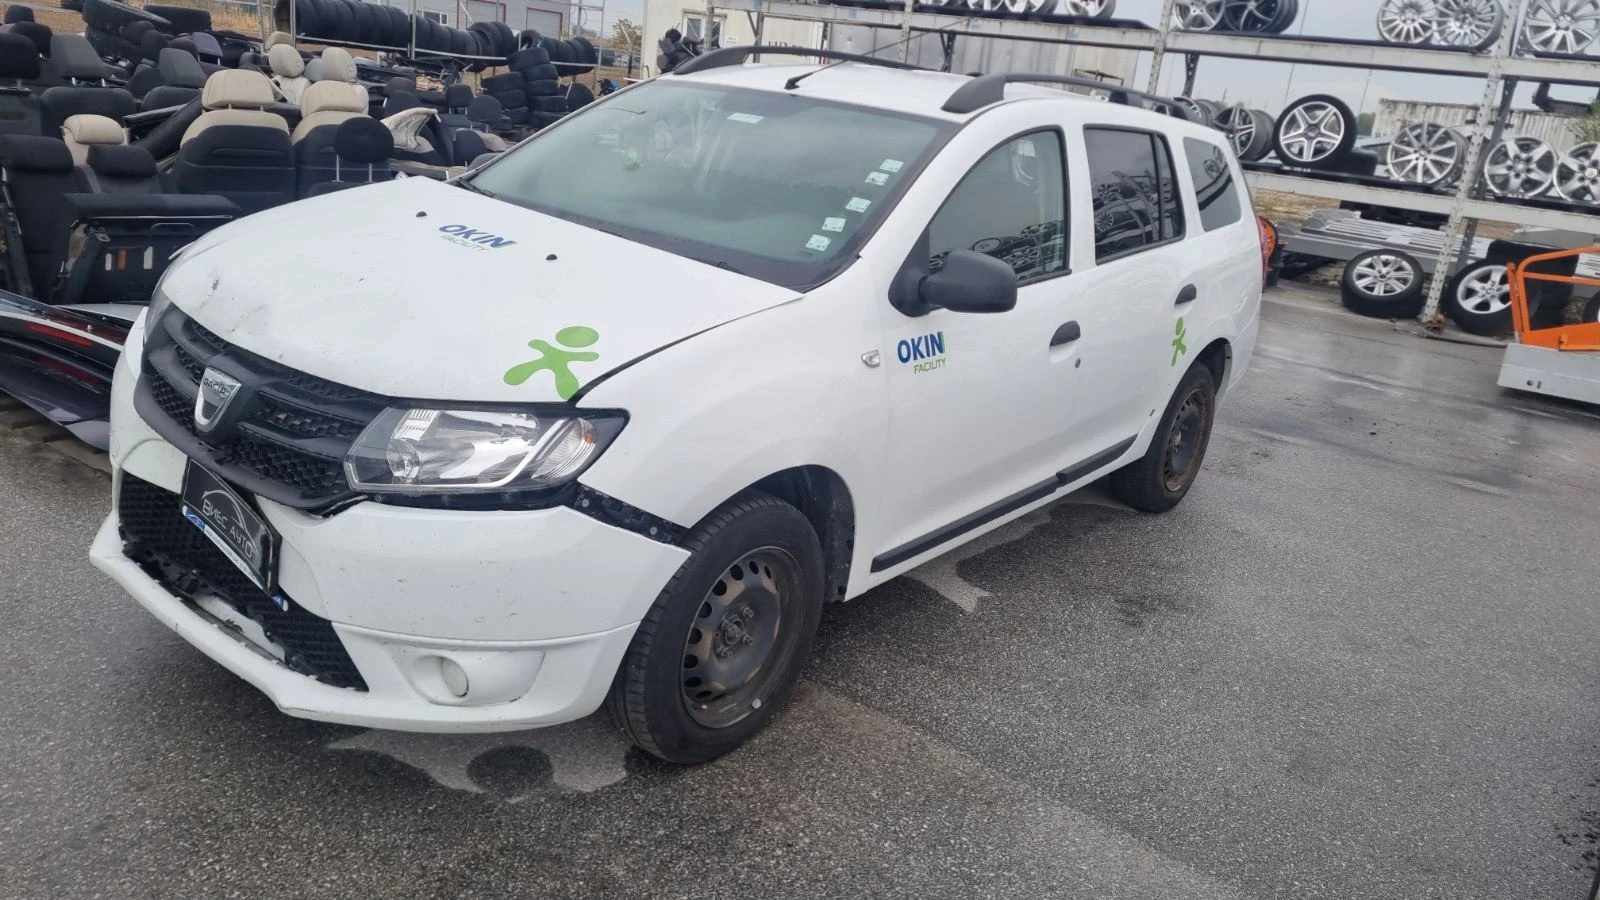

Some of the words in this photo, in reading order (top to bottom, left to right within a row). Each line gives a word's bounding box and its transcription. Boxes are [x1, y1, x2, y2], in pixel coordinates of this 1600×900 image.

[438, 224, 518, 249] OKIN
[439, 235, 491, 252] FACILITY
[897, 331, 945, 364] OKIN
[913, 357, 946, 375] FACILITY
[203, 377, 227, 395] DACIA
